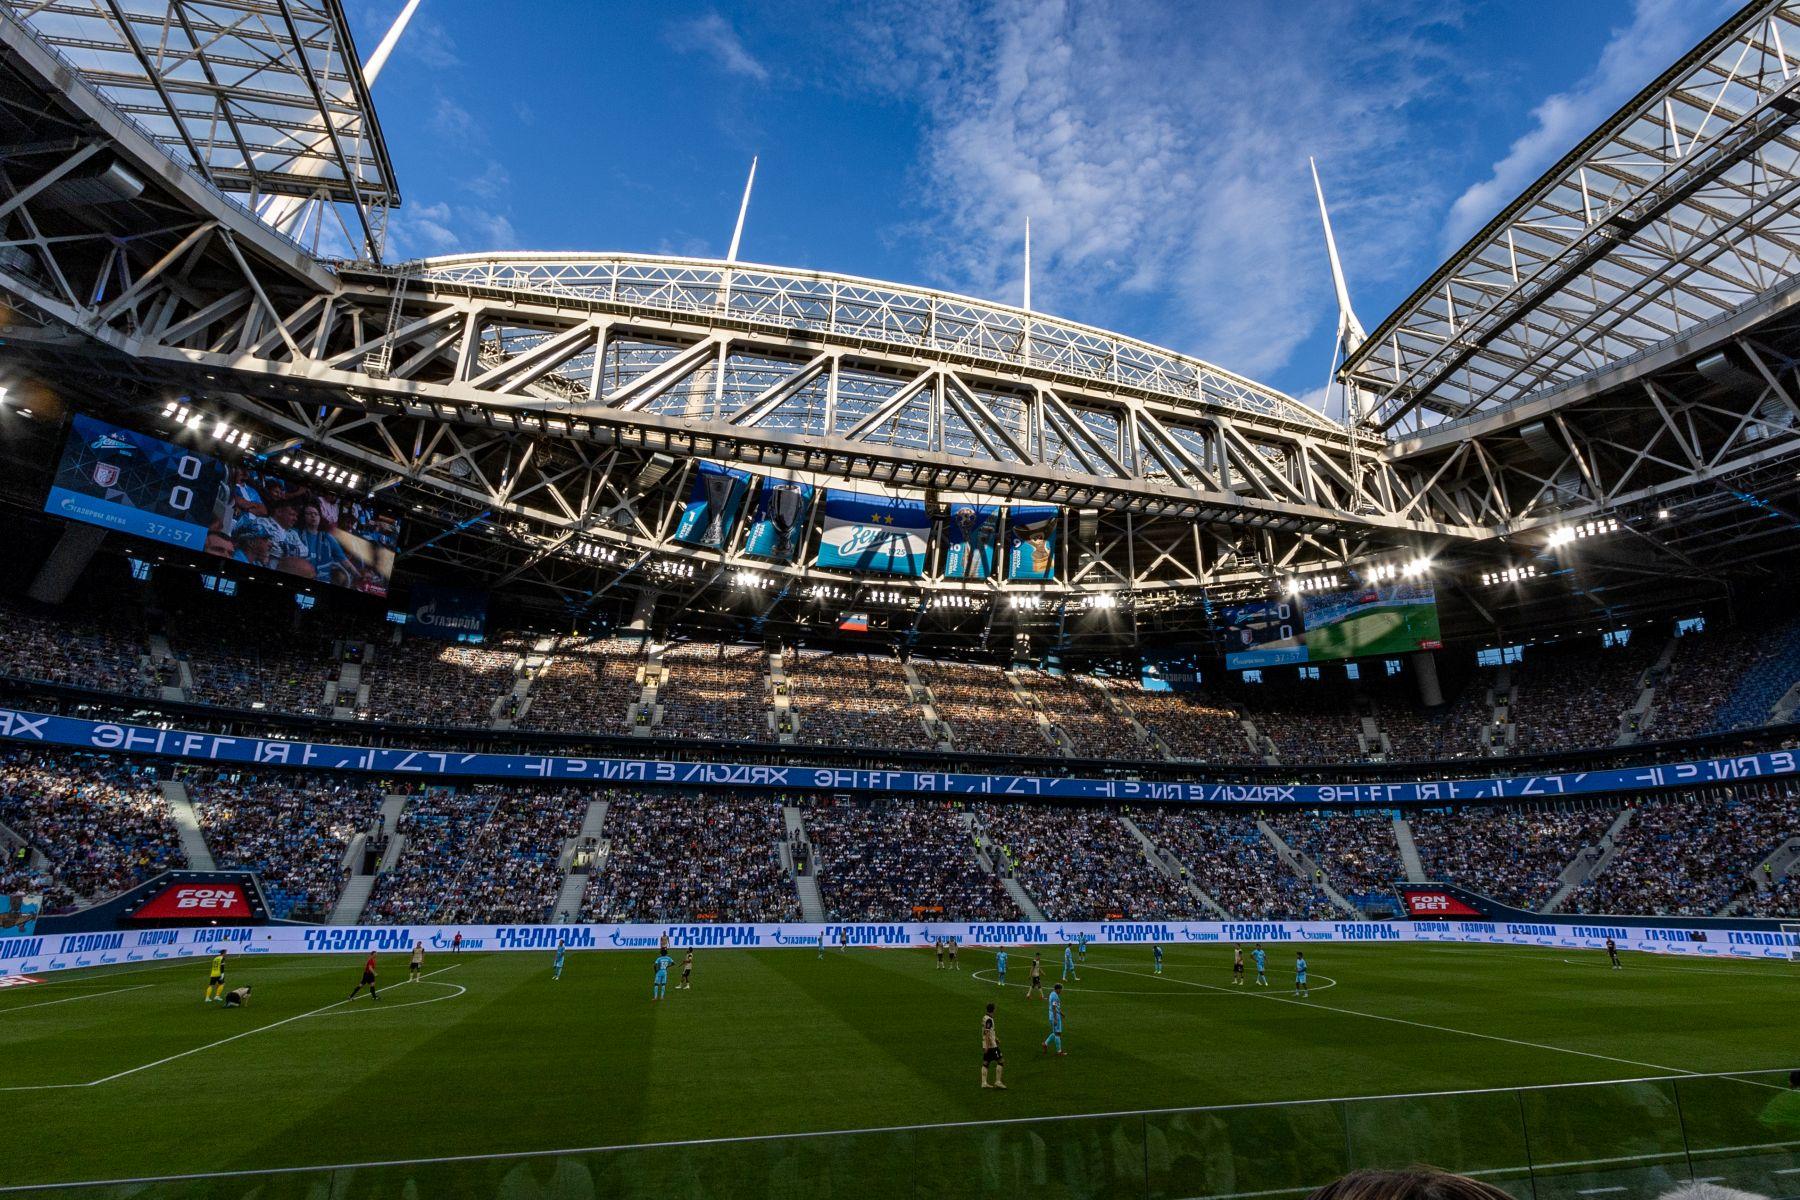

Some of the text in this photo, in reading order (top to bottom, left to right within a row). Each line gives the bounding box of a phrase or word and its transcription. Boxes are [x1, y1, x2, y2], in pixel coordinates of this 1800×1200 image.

[178, 455, 202, 480] 0
[169, 485, 193, 510] 0
[145, 522, 193, 542] 37:57
[1278, 603, 1290, 619] 0
[1280, 625, 1292, 640] 0
[177, 889, 235, 898] FON
[177, 898, 237, 908] BET
[1415, 902, 1449, 910] BET
[193, 928, 253, 943] ГАЗПРОМ
[968, 925, 1048, 943] ГАЗПРОМ
[1100, 925, 1175, 941] ГАЗПРОМ
[1222, 924, 1292, 940] ГАЗПРОМ
[1335, 924, 1400, 940] ГАЗПРОМ
[1414, 923, 1450, 932] ГАЗПРОМ
[1461, 923, 1496, 933] ГАЗПРОМ
[1506, 924, 1557, 937] ГАЗПРОМ
[1572, 926, 1628, 940] ГАЗПРОМ
[60, 933, 124, 954] ГАЗПРОМ
[138, 930, 179, 946] ГАЗПРОМ
[303, 929, 414, 950] ГАЗПРОМ
[496, 927, 596, 948] ГАЗПРОМ
[625, 937, 659, 947] ГАЗПРОМ
[668, 926, 761, 946] ГАЗПРОМ
[787, 936, 818, 945] ГАЗПРОМ
